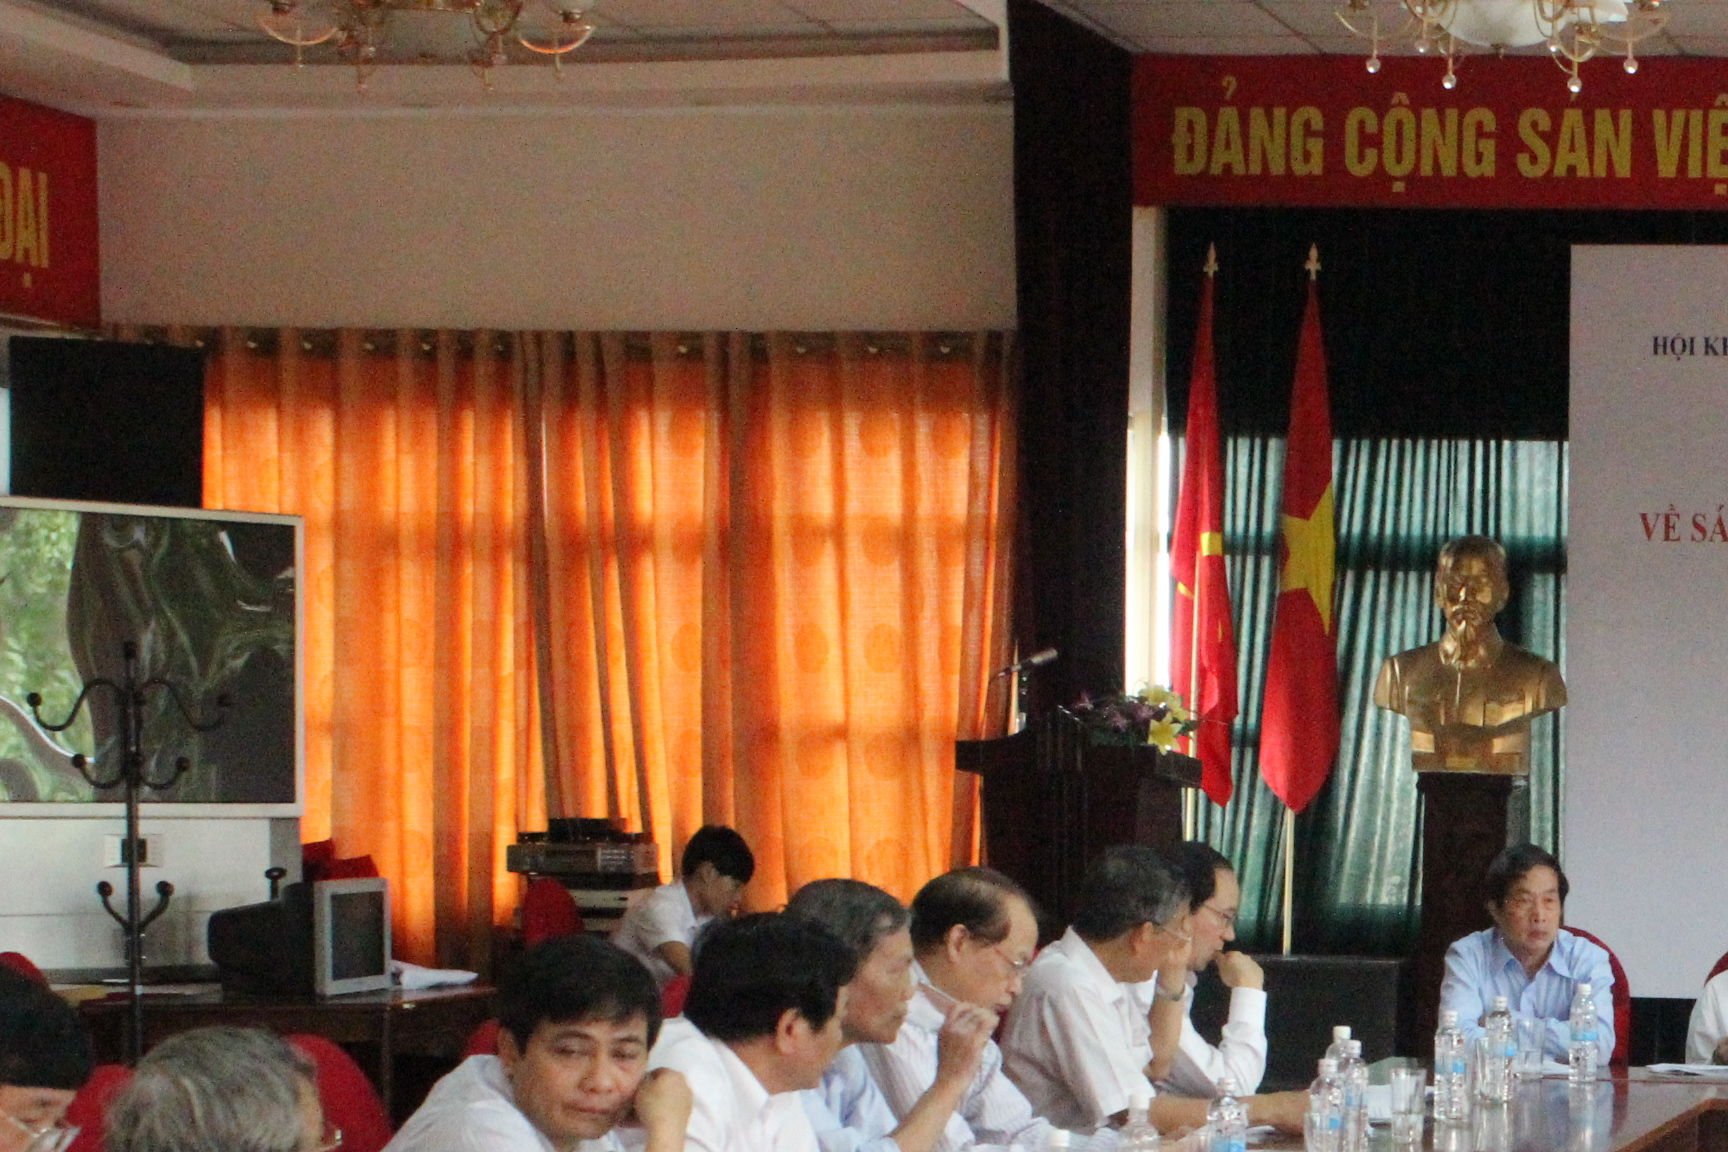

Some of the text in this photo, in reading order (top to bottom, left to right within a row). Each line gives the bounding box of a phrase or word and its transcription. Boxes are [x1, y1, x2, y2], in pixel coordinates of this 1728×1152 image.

[1172, 75, 1326, 177] ĐẢNG
[1344, 92, 1497, 193] CỘNG
[1652, 333, 1695, 361] HỘI
[1639, 503, 1683, 543] VỀ
